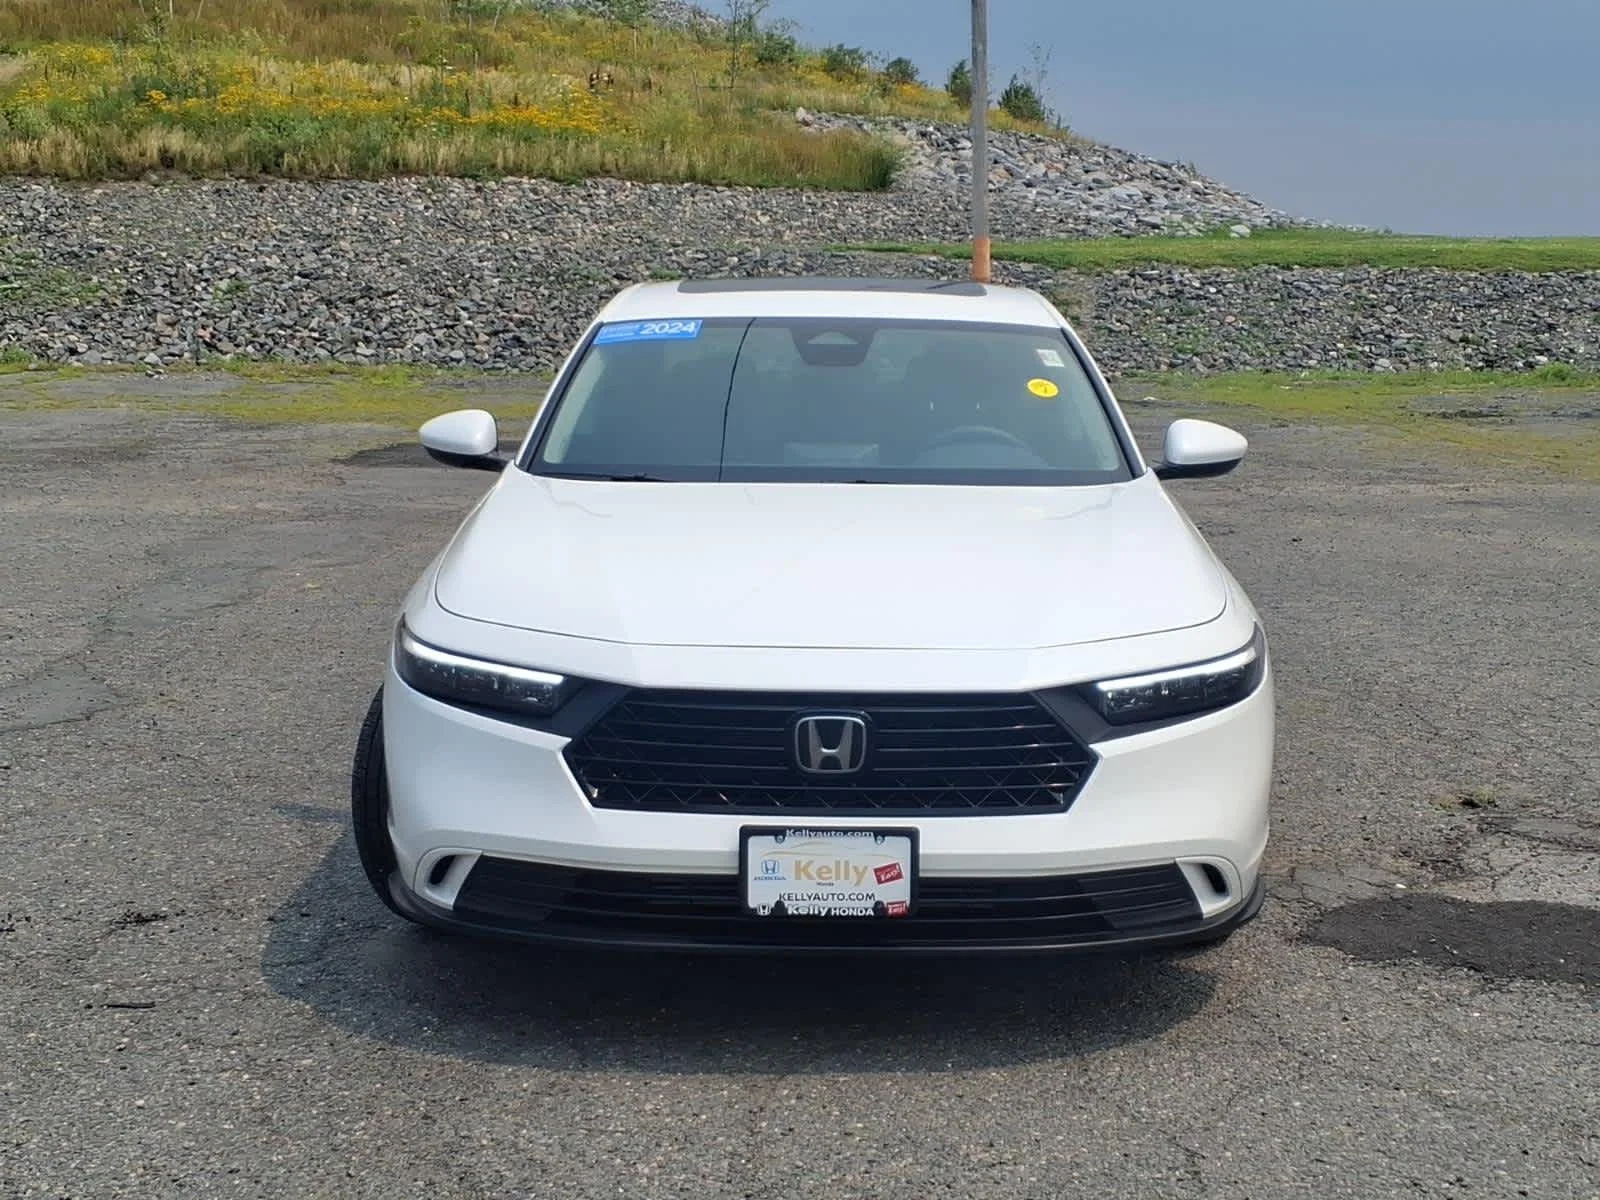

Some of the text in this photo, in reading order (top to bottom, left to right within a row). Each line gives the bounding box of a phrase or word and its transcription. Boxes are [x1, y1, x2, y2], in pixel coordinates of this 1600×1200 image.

[640, 322, 696, 334] 2024
[786, 829, 874, 838] Kellyauto.com
[794, 860, 868, 886] Kelly
[779, 892, 876, 901] KELLYAUTO.COM
[787, 904, 875, 916] Kelly HONDA
